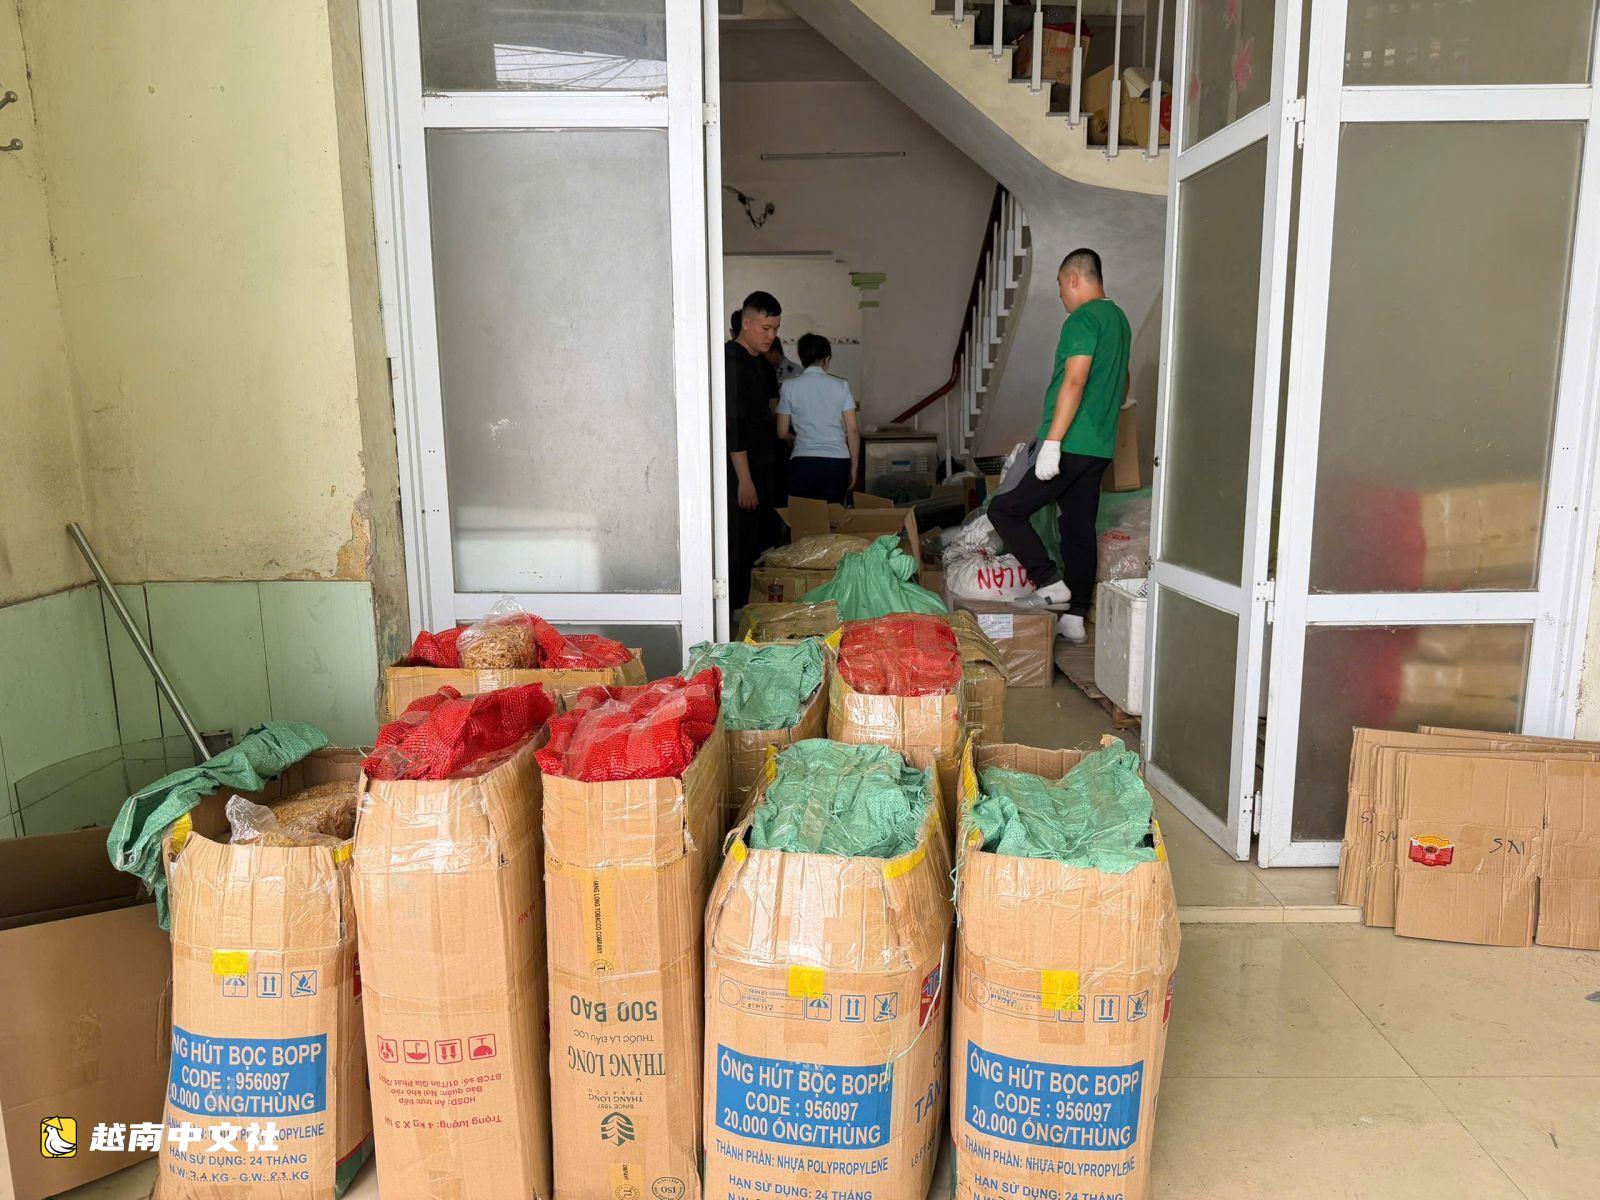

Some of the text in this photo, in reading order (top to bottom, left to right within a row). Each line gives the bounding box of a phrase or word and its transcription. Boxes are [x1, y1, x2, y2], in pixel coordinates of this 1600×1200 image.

[570, 995, 658, 1022] 500 BAO
[173, 1034, 322, 1071] NG HÚT BỌC BOPP
[568, 1045, 666, 1082] THĂNG LONG
[181, 1065, 221, 1090] CODE
[236, 1072, 290, 1091] 956097
[720, 1050, 889, 1098] ỐNG HÚT BỌC BOPP
[970, 1048, 1140, 1100] ỐNG HÚT BỌC BOPP
[170, 1083, 200, 1110] 0.000
[745, 1091, 791, 1116] CODE
[804, 1099, 859, 1121] 956097
[994, 1090, 1041, 1117] CODE
[1056, 1100, 1112, 1123] 956097
[395, 1120, 401, 1128] 3
[413, 1119, 425, 1128] kg
[724, 1107, 881, 1145] 20.000 ỐNG/THÙNG
[972, 1104, 1131, 1147] 20.000 ỐNG/THÙNG
[209, 1155, 246, 1167] DỤNG:
[250, 1157, 263, 1165] 24
[267, 1153, 307, 1165] THÁNG
[807, 1157, 888, 1175] POLYPROPYLENE
[1057, 1156, 1135, 1177] POLYPROPYLENE
[660, 1186, 676, 1194] ISO
[729, 1174, 751, 1190] HẠN
[775, 1184, 812, 1198] DỤNG:
[815, 1190, 828, 1200] 24
[831, 1187, 872, 1200] THÁNG
[974, 1174, 998, 1190] HẠN
[1023, 1186, 1061, 1200] DỤNG:
[1065, 1192, 1078, 1200] 24
